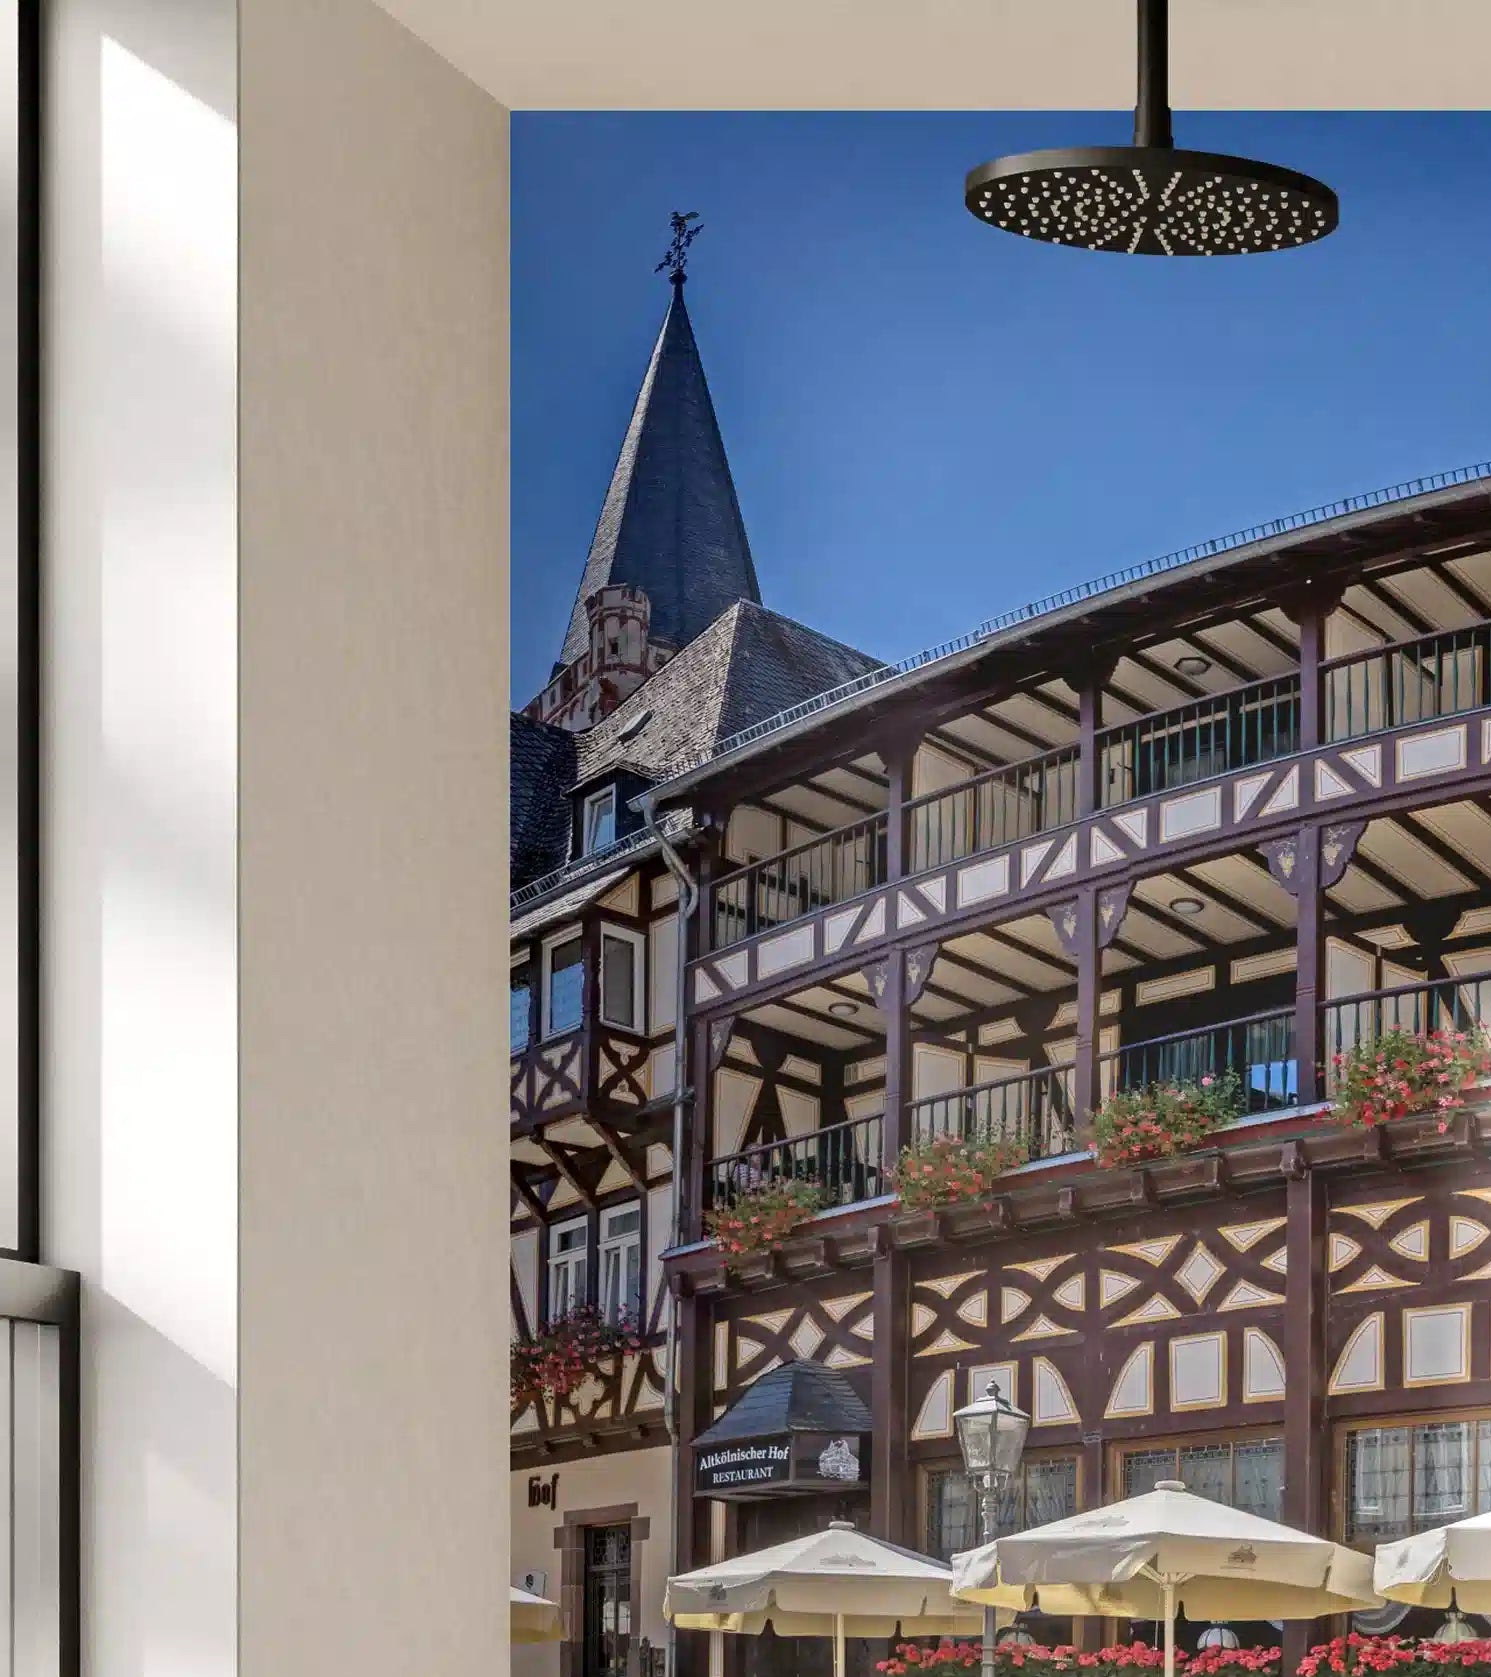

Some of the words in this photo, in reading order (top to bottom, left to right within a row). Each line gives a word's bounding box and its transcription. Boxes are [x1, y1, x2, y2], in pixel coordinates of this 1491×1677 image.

[699, 1447, 767, 1471] Altkölnischer
[768, 1445, 789, 1460] Hof
[712, 1466, 774, 1484] RESTAURANT
